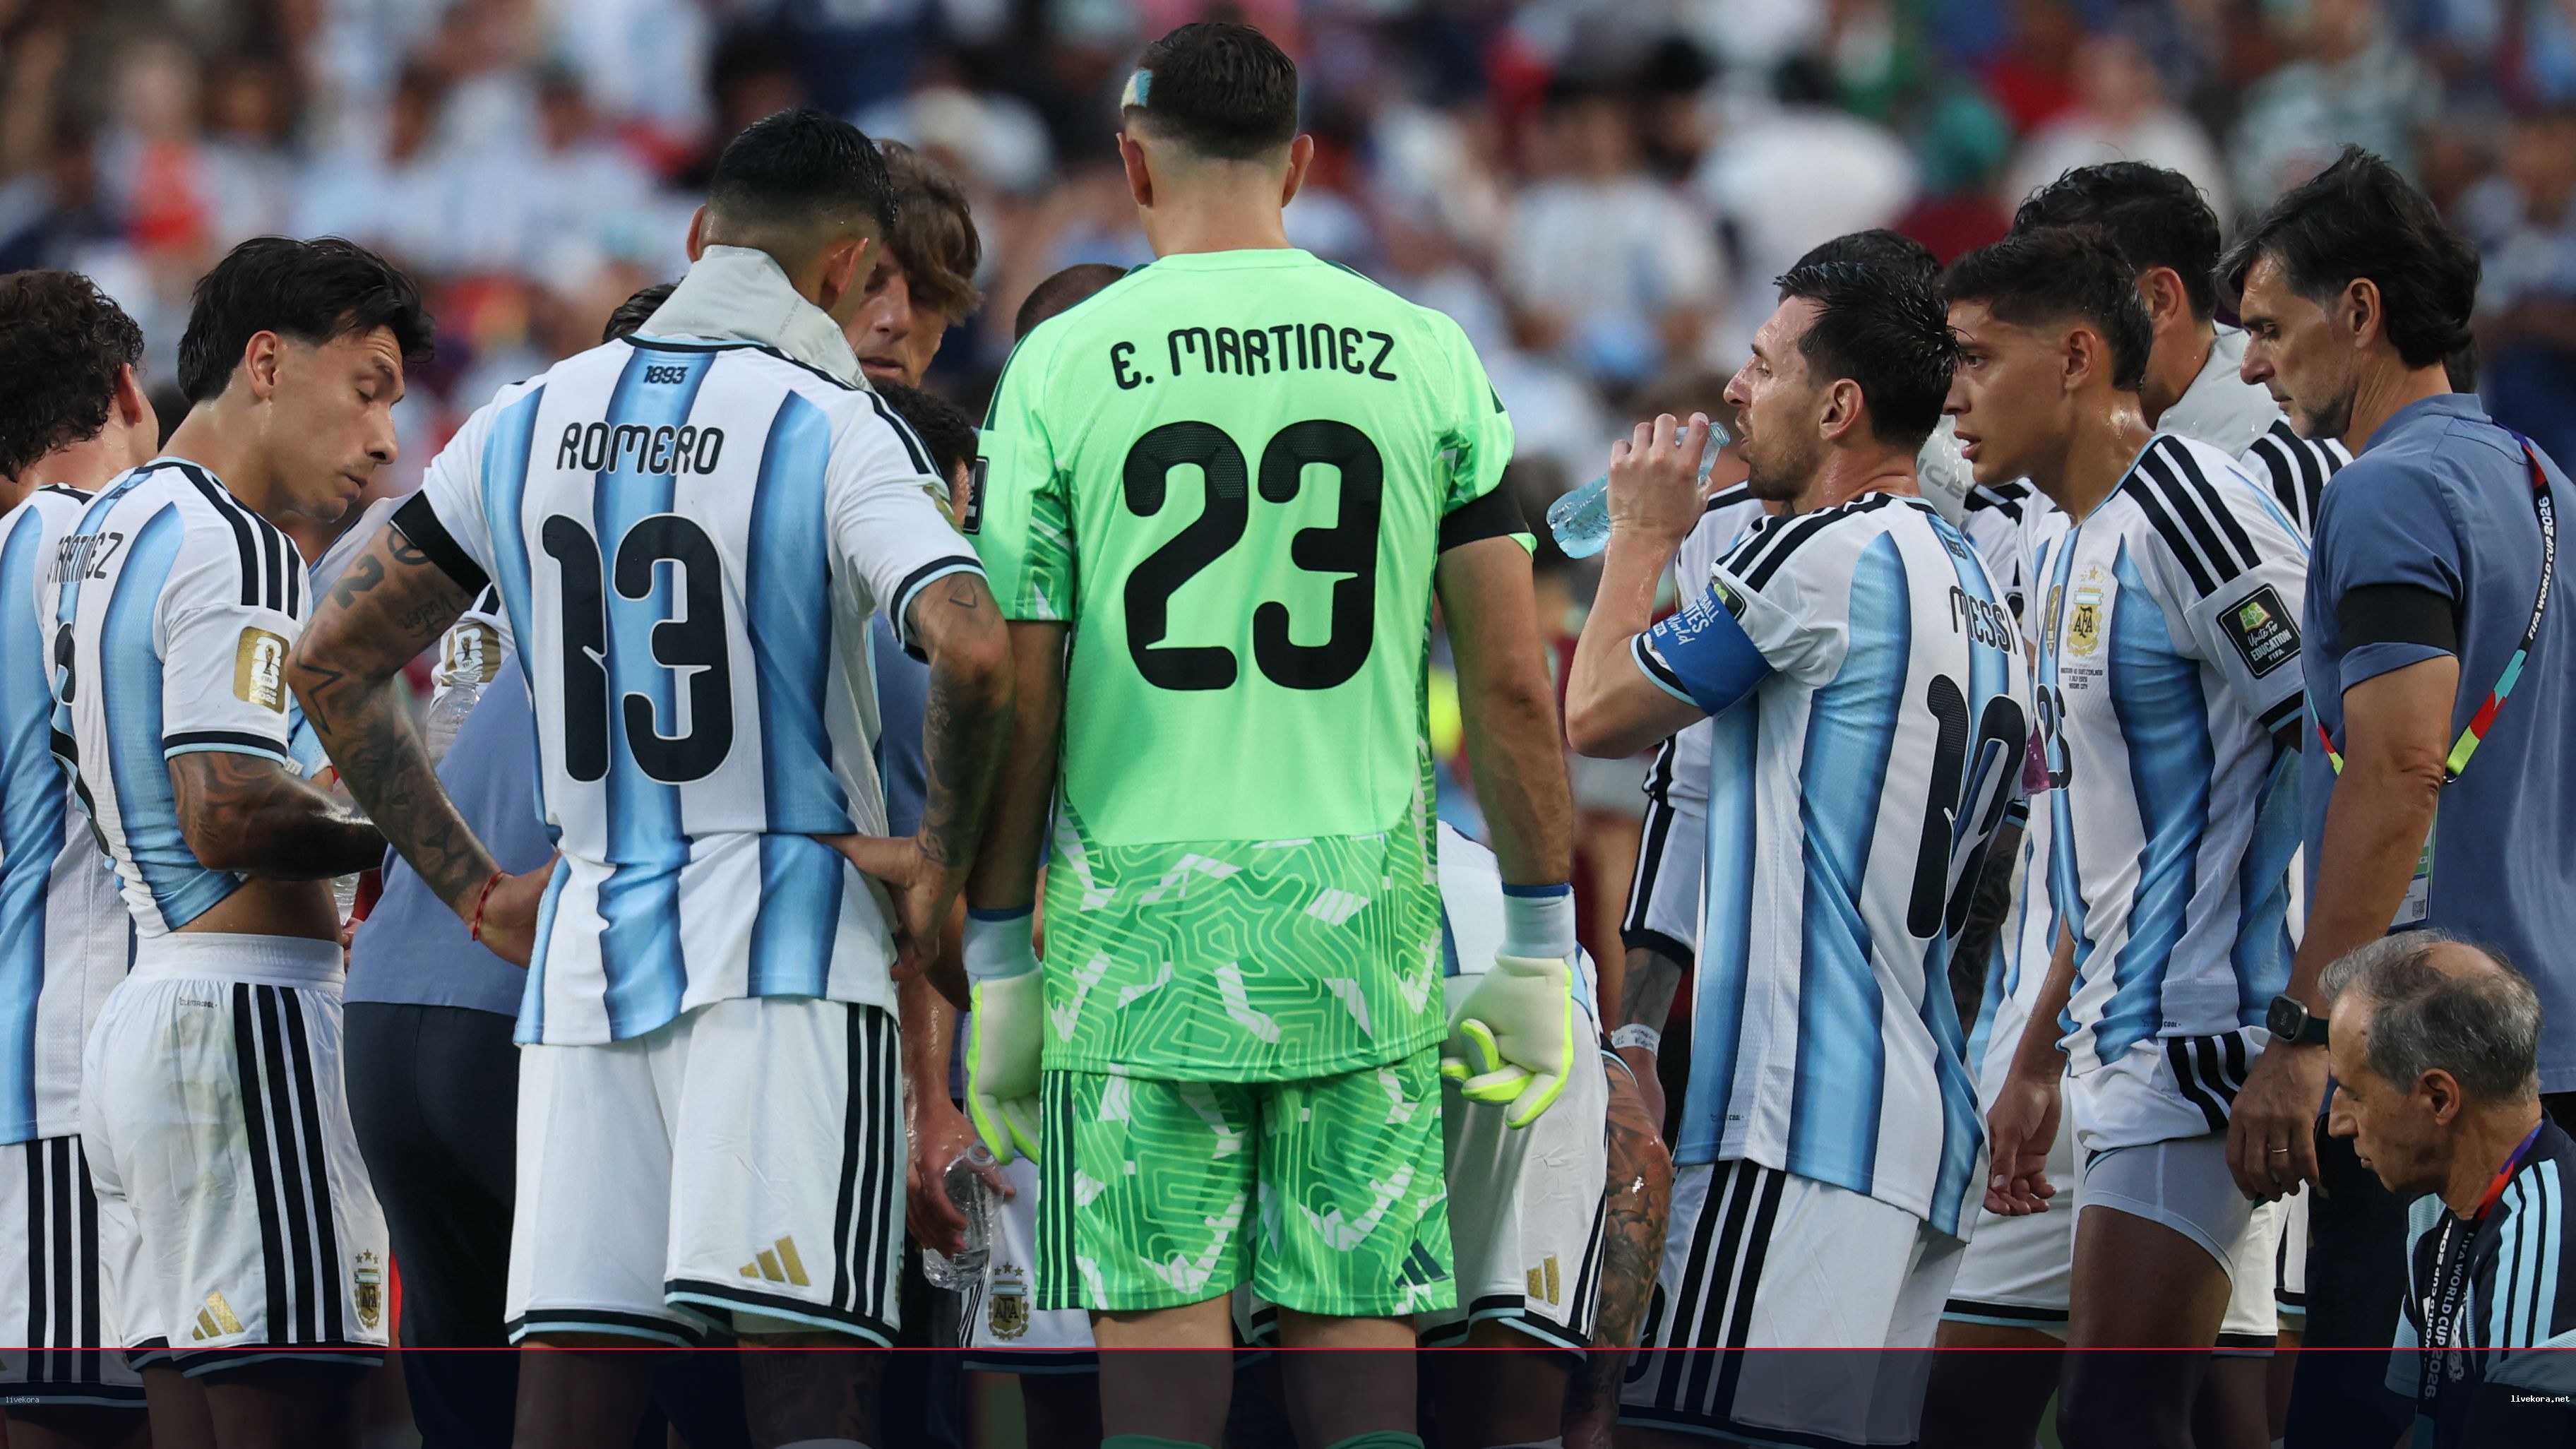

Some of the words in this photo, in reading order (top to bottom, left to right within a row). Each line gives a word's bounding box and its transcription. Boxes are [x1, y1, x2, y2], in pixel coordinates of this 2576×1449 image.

[643, 365, 689, 383] 1893
[1110, 342, 1155, 390] E.
[1167, 322, 1397, 381] MARTINEZ
[556, 422, 724, 475] ROMERO
[2538, 496, 2554, 537] 2026
[47, 532, 124, 583] ARTINEZ
[1123, 419, 1384, 691] 23
[2545, 537, 2555, 562] CUP
[2537, 564, 2552, 610] WORLD
[1950, 585, 2017, 655] MESSI
[2527, 612, 2542, 640] FIFA
[541, 514, 735, 785] 13
[2250, 628, 2292, 662] EDUCATION
[2267, 648, 2285, 661] FIFA
[1907, 674, 2027, 940] 10
[2431, 1266, 2440, 1298] CUP
[2441, 1261, 2464, 1315] WORLD
[2435, 1316, 2449, 1346] CUP
[2424, 1348, 2444, 1399] 2026
